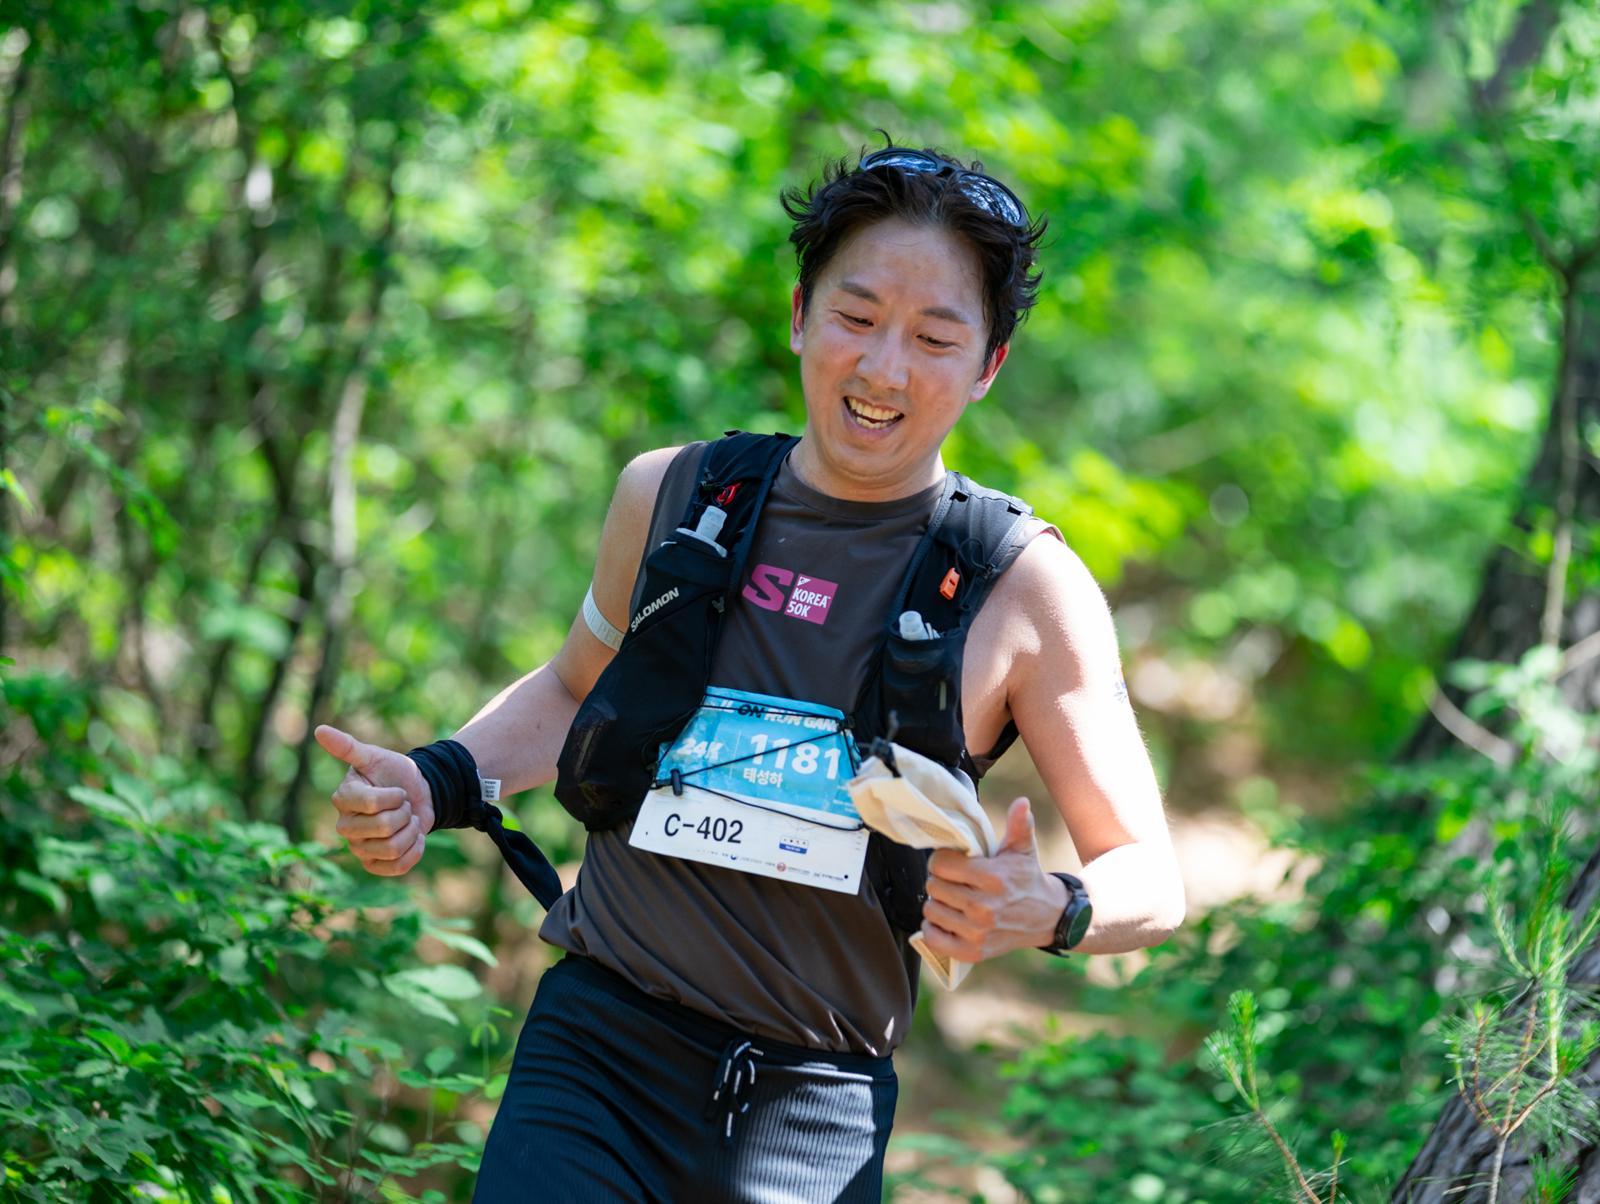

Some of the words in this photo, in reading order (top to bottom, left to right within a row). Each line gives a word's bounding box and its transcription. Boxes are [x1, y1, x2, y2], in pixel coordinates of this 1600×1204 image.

[786, 601, 811, 617] 50K
[792, 588, 829, 608] KOREA
[630, 587, 679, 632] SALOMON
[764, 708, 802, 727] RUN
[676, 737, 723, 760] 24K
[750, 733, 841, 780] 1181
[743, 767, 783, 788] 태성하
[663, 813, 744, 844] C-402
